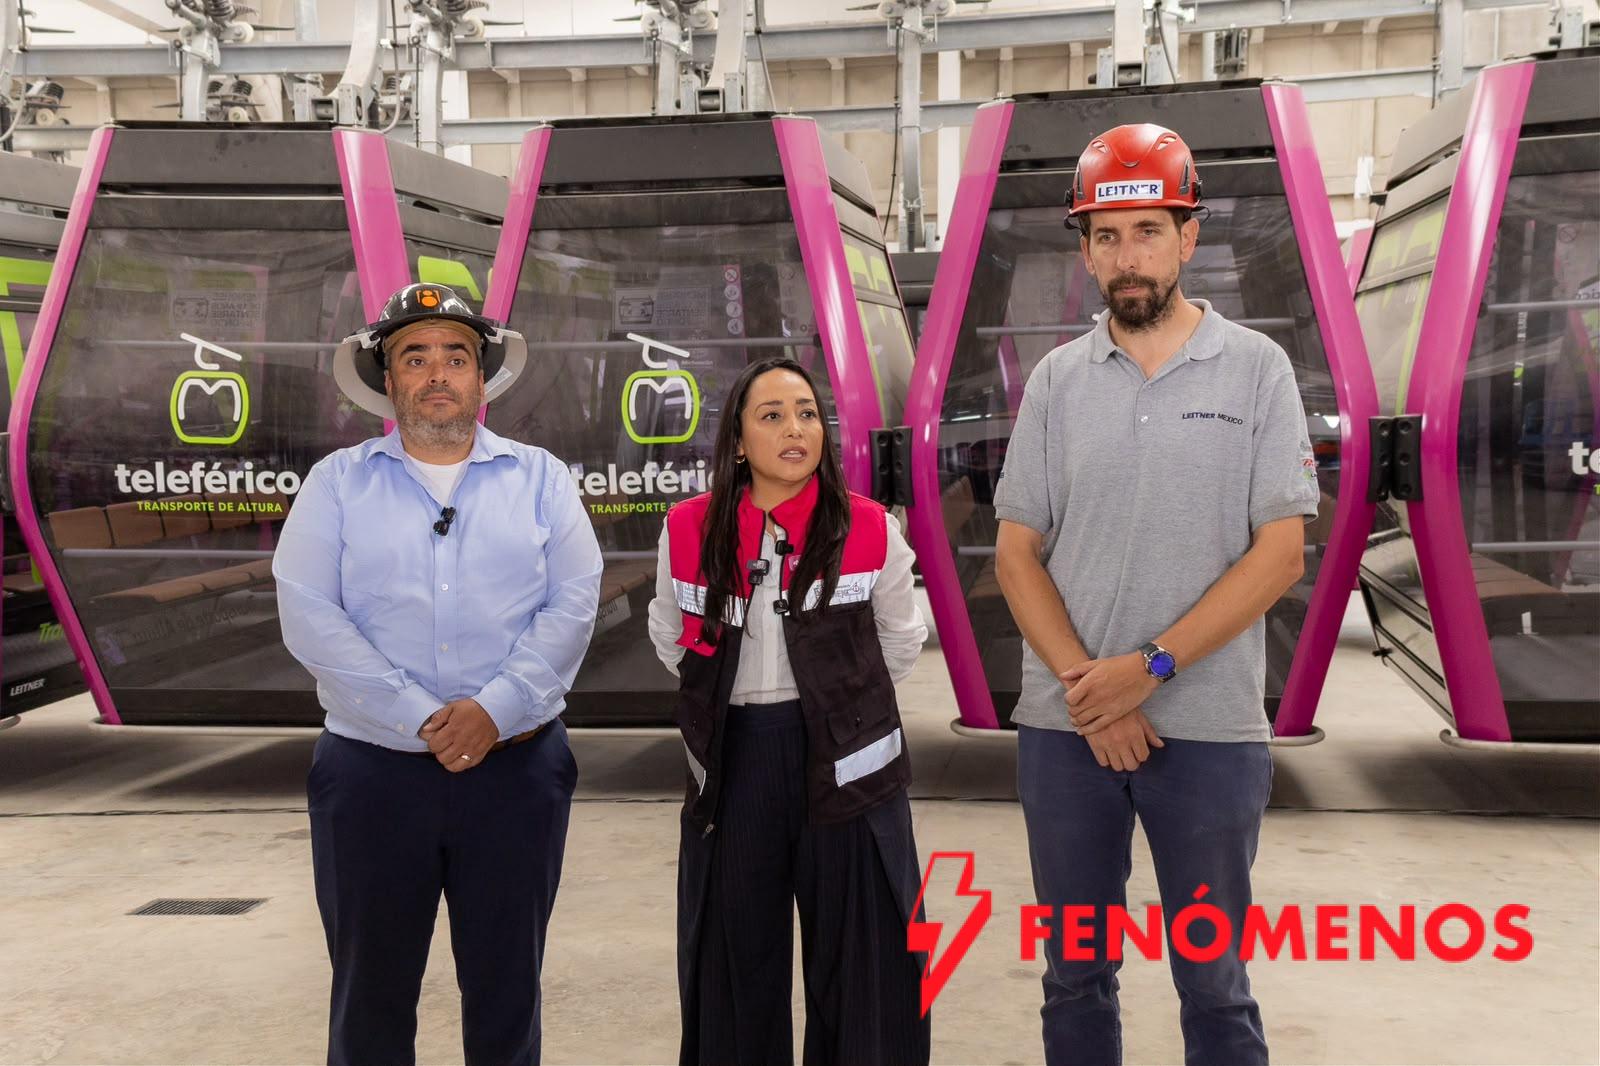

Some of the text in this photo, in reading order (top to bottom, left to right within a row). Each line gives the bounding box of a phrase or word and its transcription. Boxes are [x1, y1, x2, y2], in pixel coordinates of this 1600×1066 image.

[1098, 184, 1158, 198] LEITNR
[1182, 412, 1243, 425] LEITNER MEXICO
[114, 461, 301, 495] teleférico
[569, 459, 714, 496] teleféri
[137, 501, 283, 513] TRANSPORTE DE ALTURA
[590, 502, 667, 514] TRANSPORTE
[10, 678, 46, 697] LEITNER
